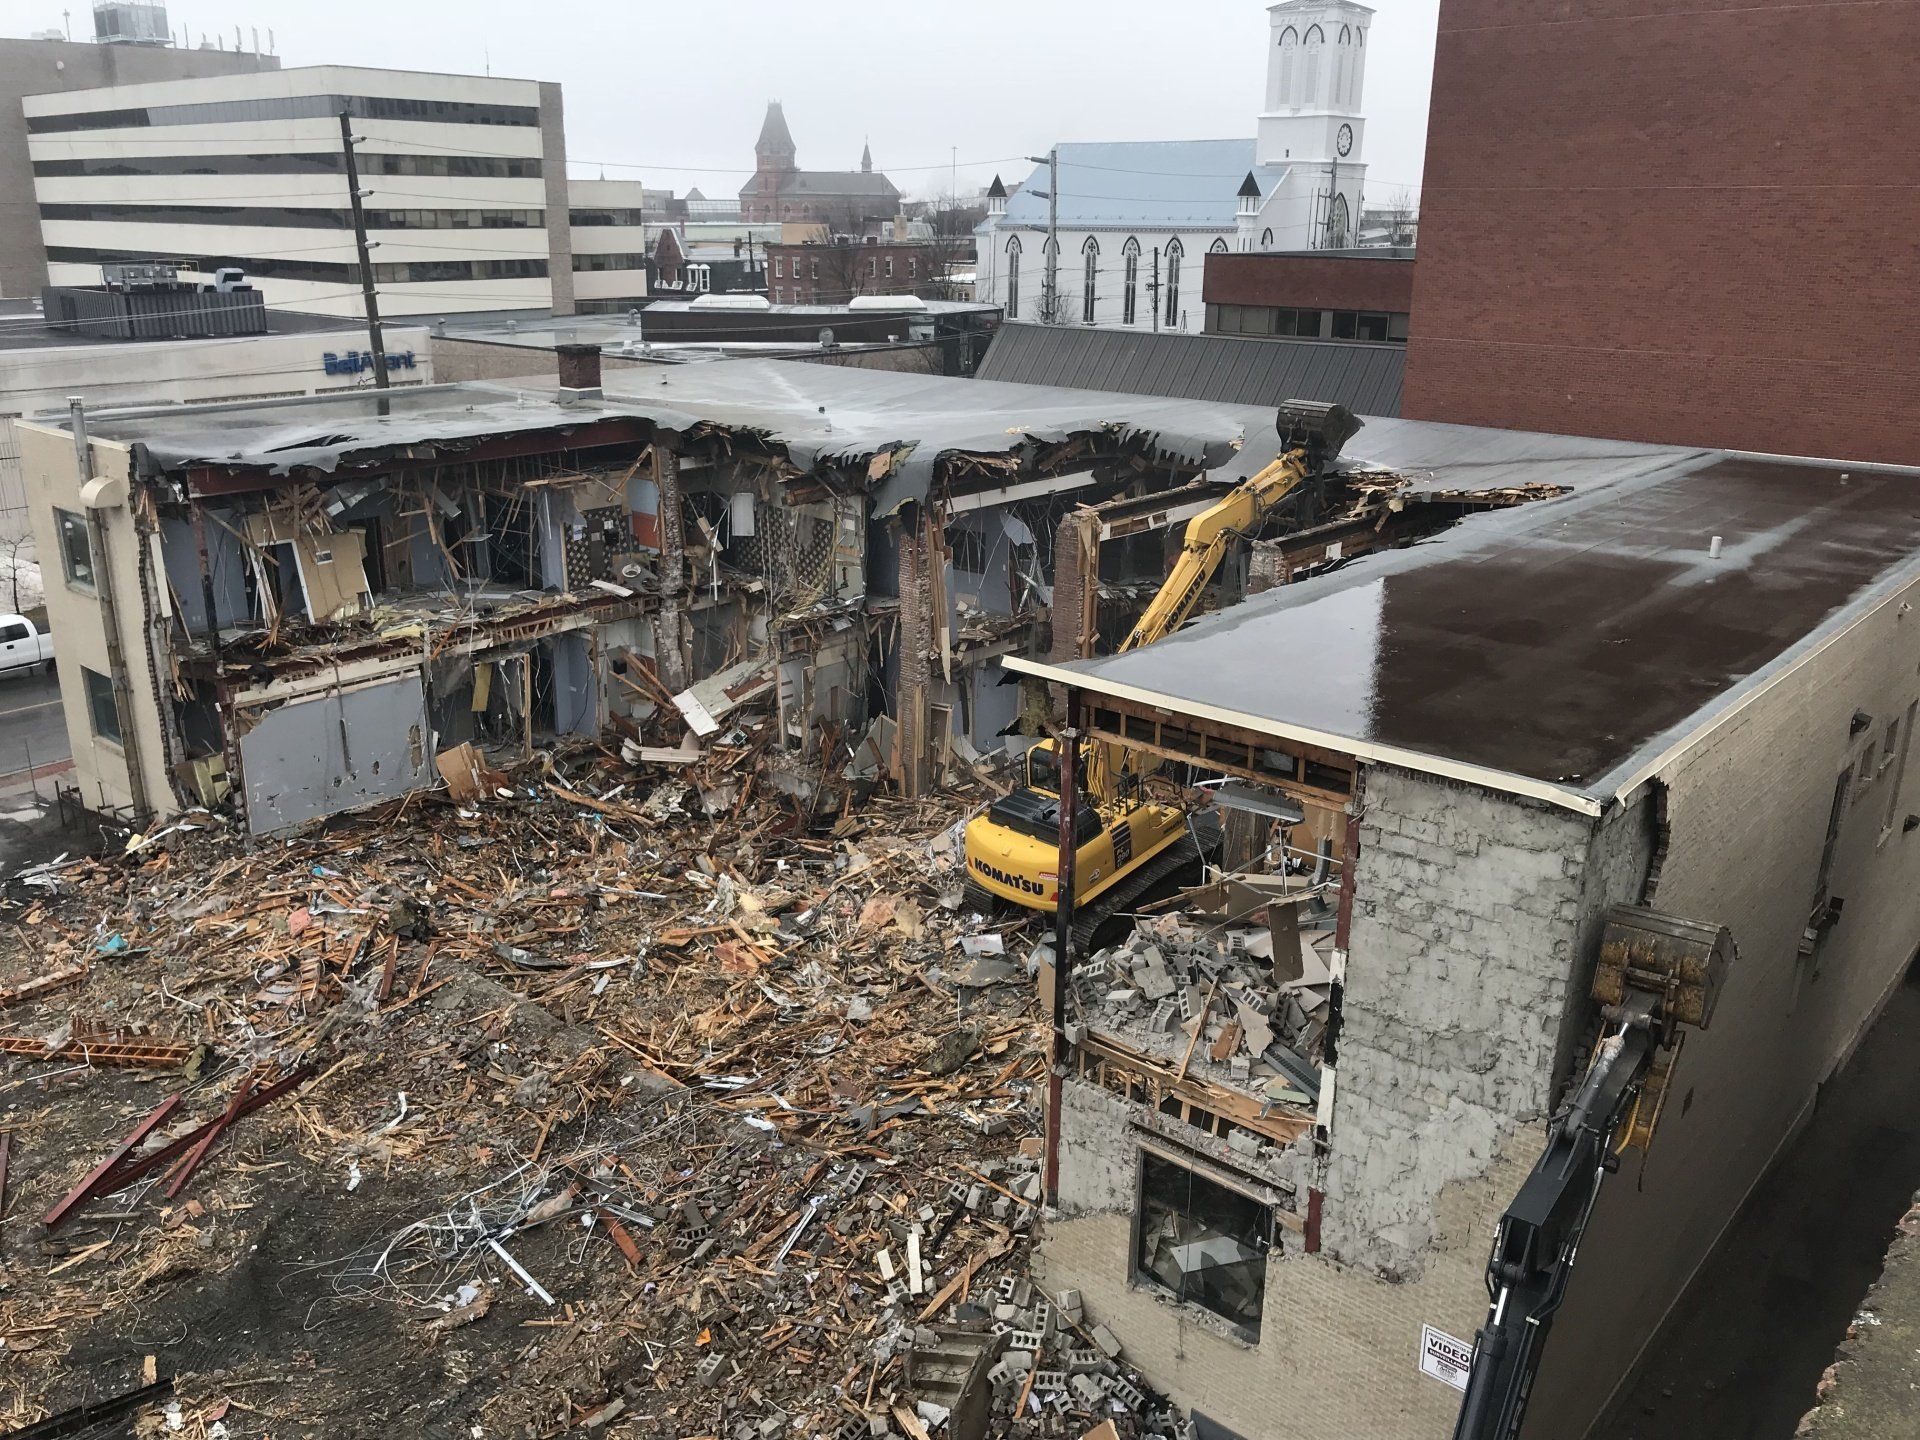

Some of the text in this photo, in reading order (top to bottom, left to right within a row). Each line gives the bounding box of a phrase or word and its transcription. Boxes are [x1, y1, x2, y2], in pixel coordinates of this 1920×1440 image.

[323, 350, 417, 375] BellAant
[1164, 569, 1206, 634] KOMATSU
[974, 857, 1044, 895] KOMATSU
[1429, 1350, 1468, 1371] SURVEILLANCE
[1430, 1338, 1469, 1363] VIDEO
